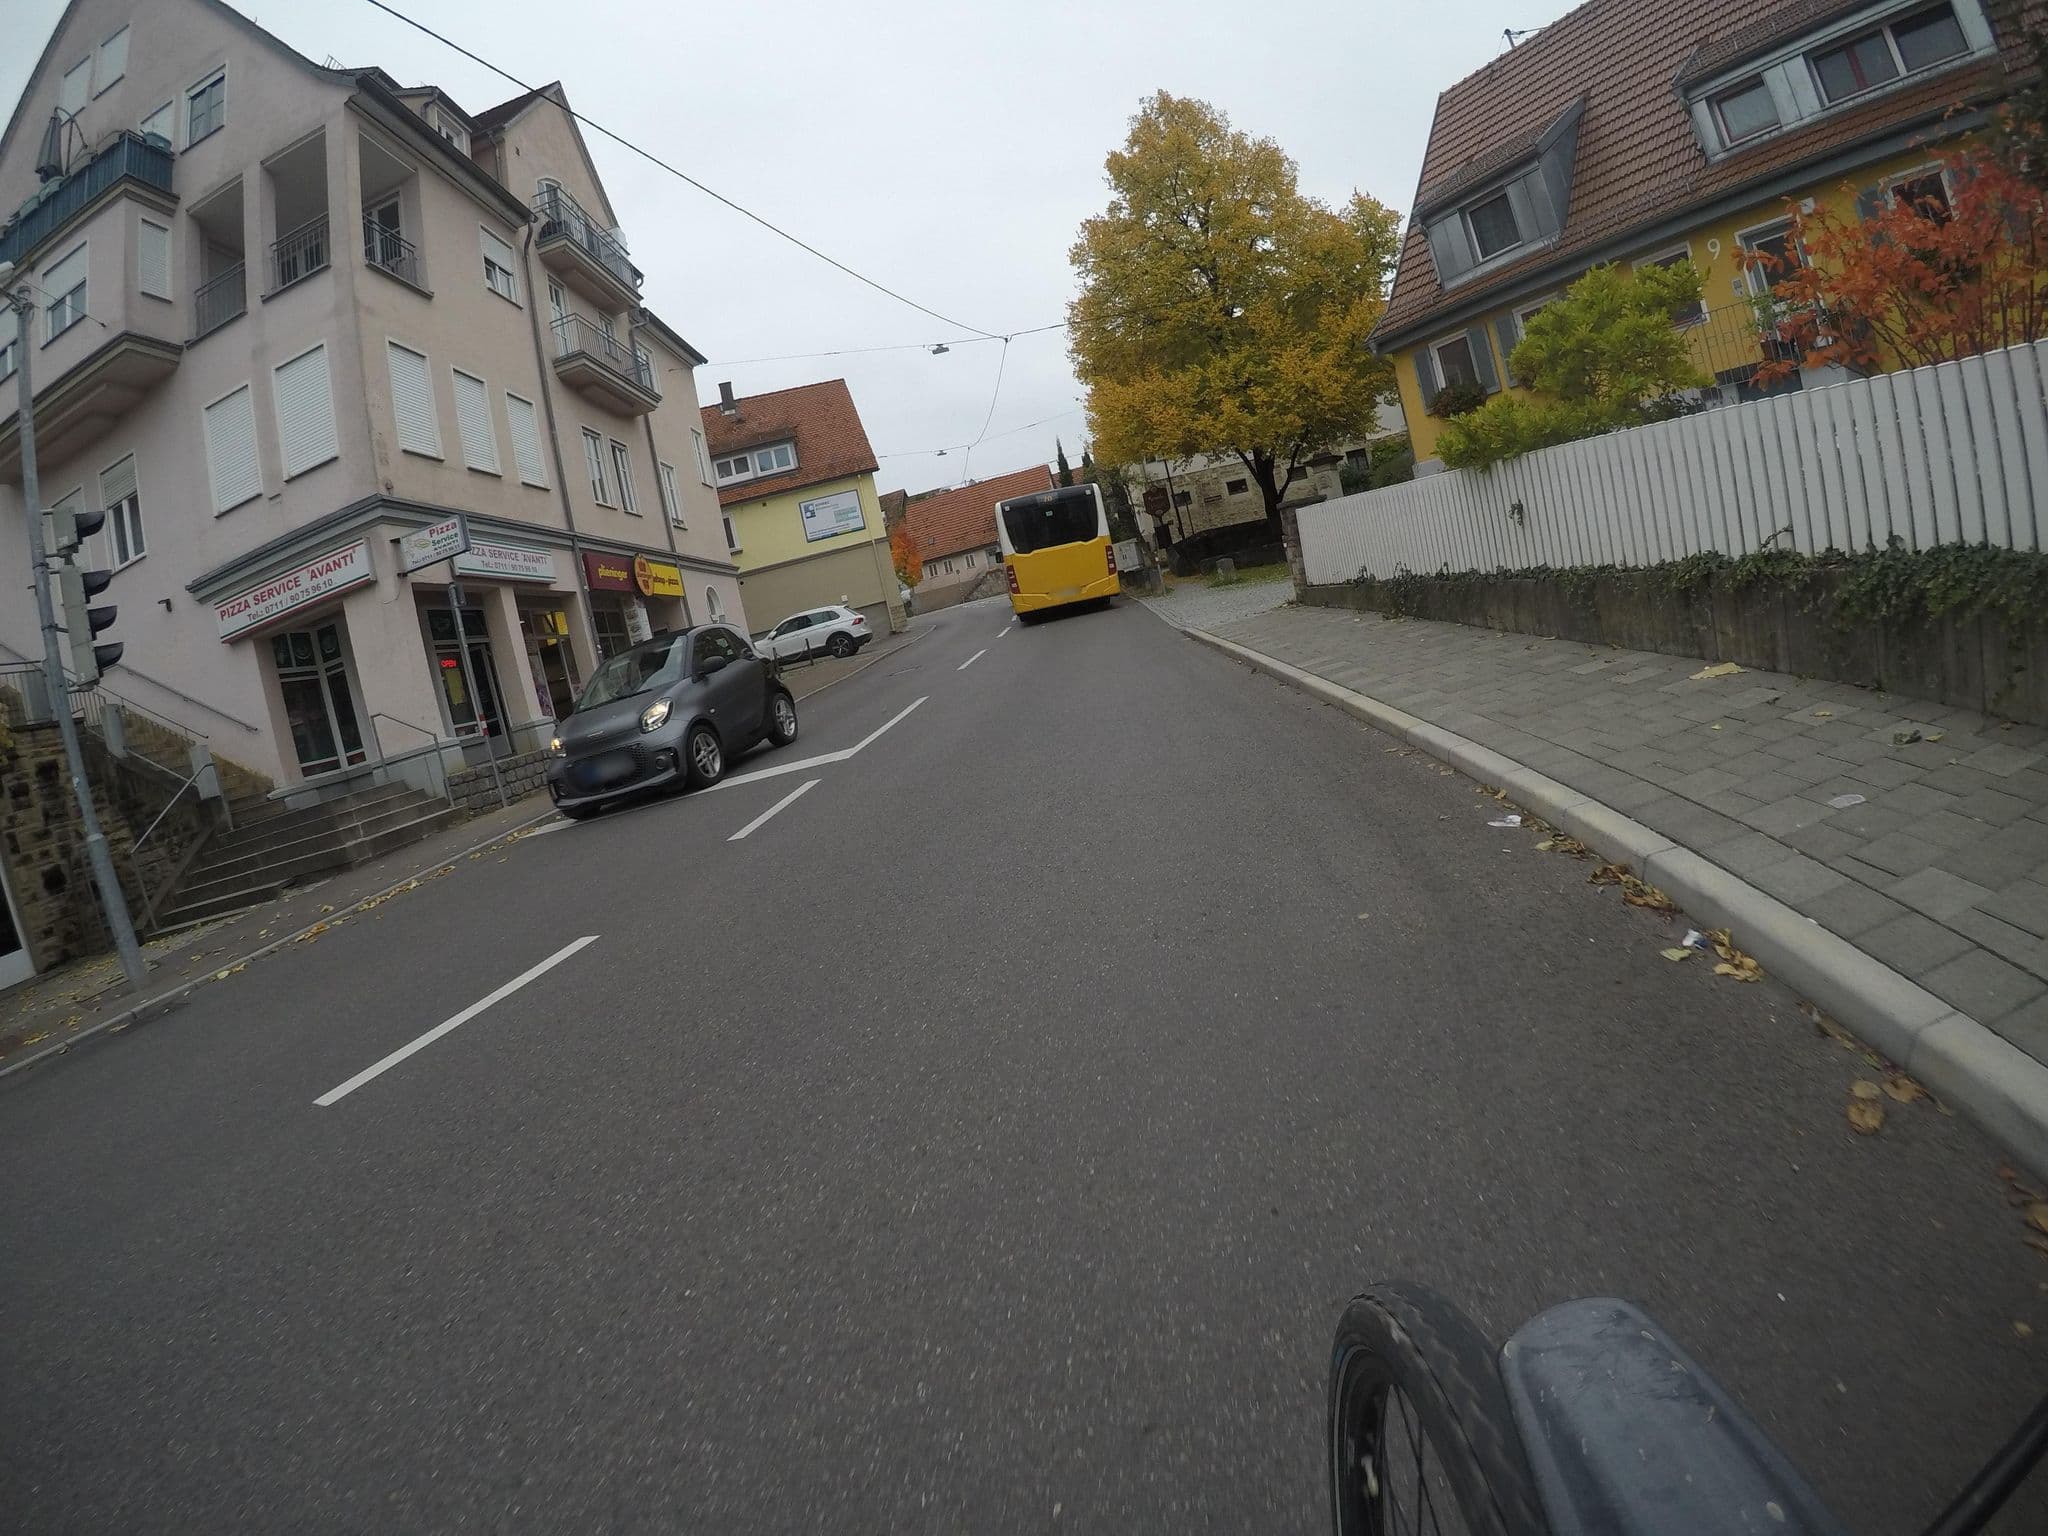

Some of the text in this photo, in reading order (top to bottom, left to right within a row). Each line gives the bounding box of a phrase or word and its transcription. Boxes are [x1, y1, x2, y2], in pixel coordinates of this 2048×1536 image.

[1707, 239, 1720, 260] 9
[429, 521, 457, 538] Pizza
[431, 533, 458, 547] Service
[488, 549, 520, 562] SERVICE
[219, 600, 251, 621] PIZZA
[253, 576, 302, 606] SERVICE
[265, 600, 284, 614] 0711
